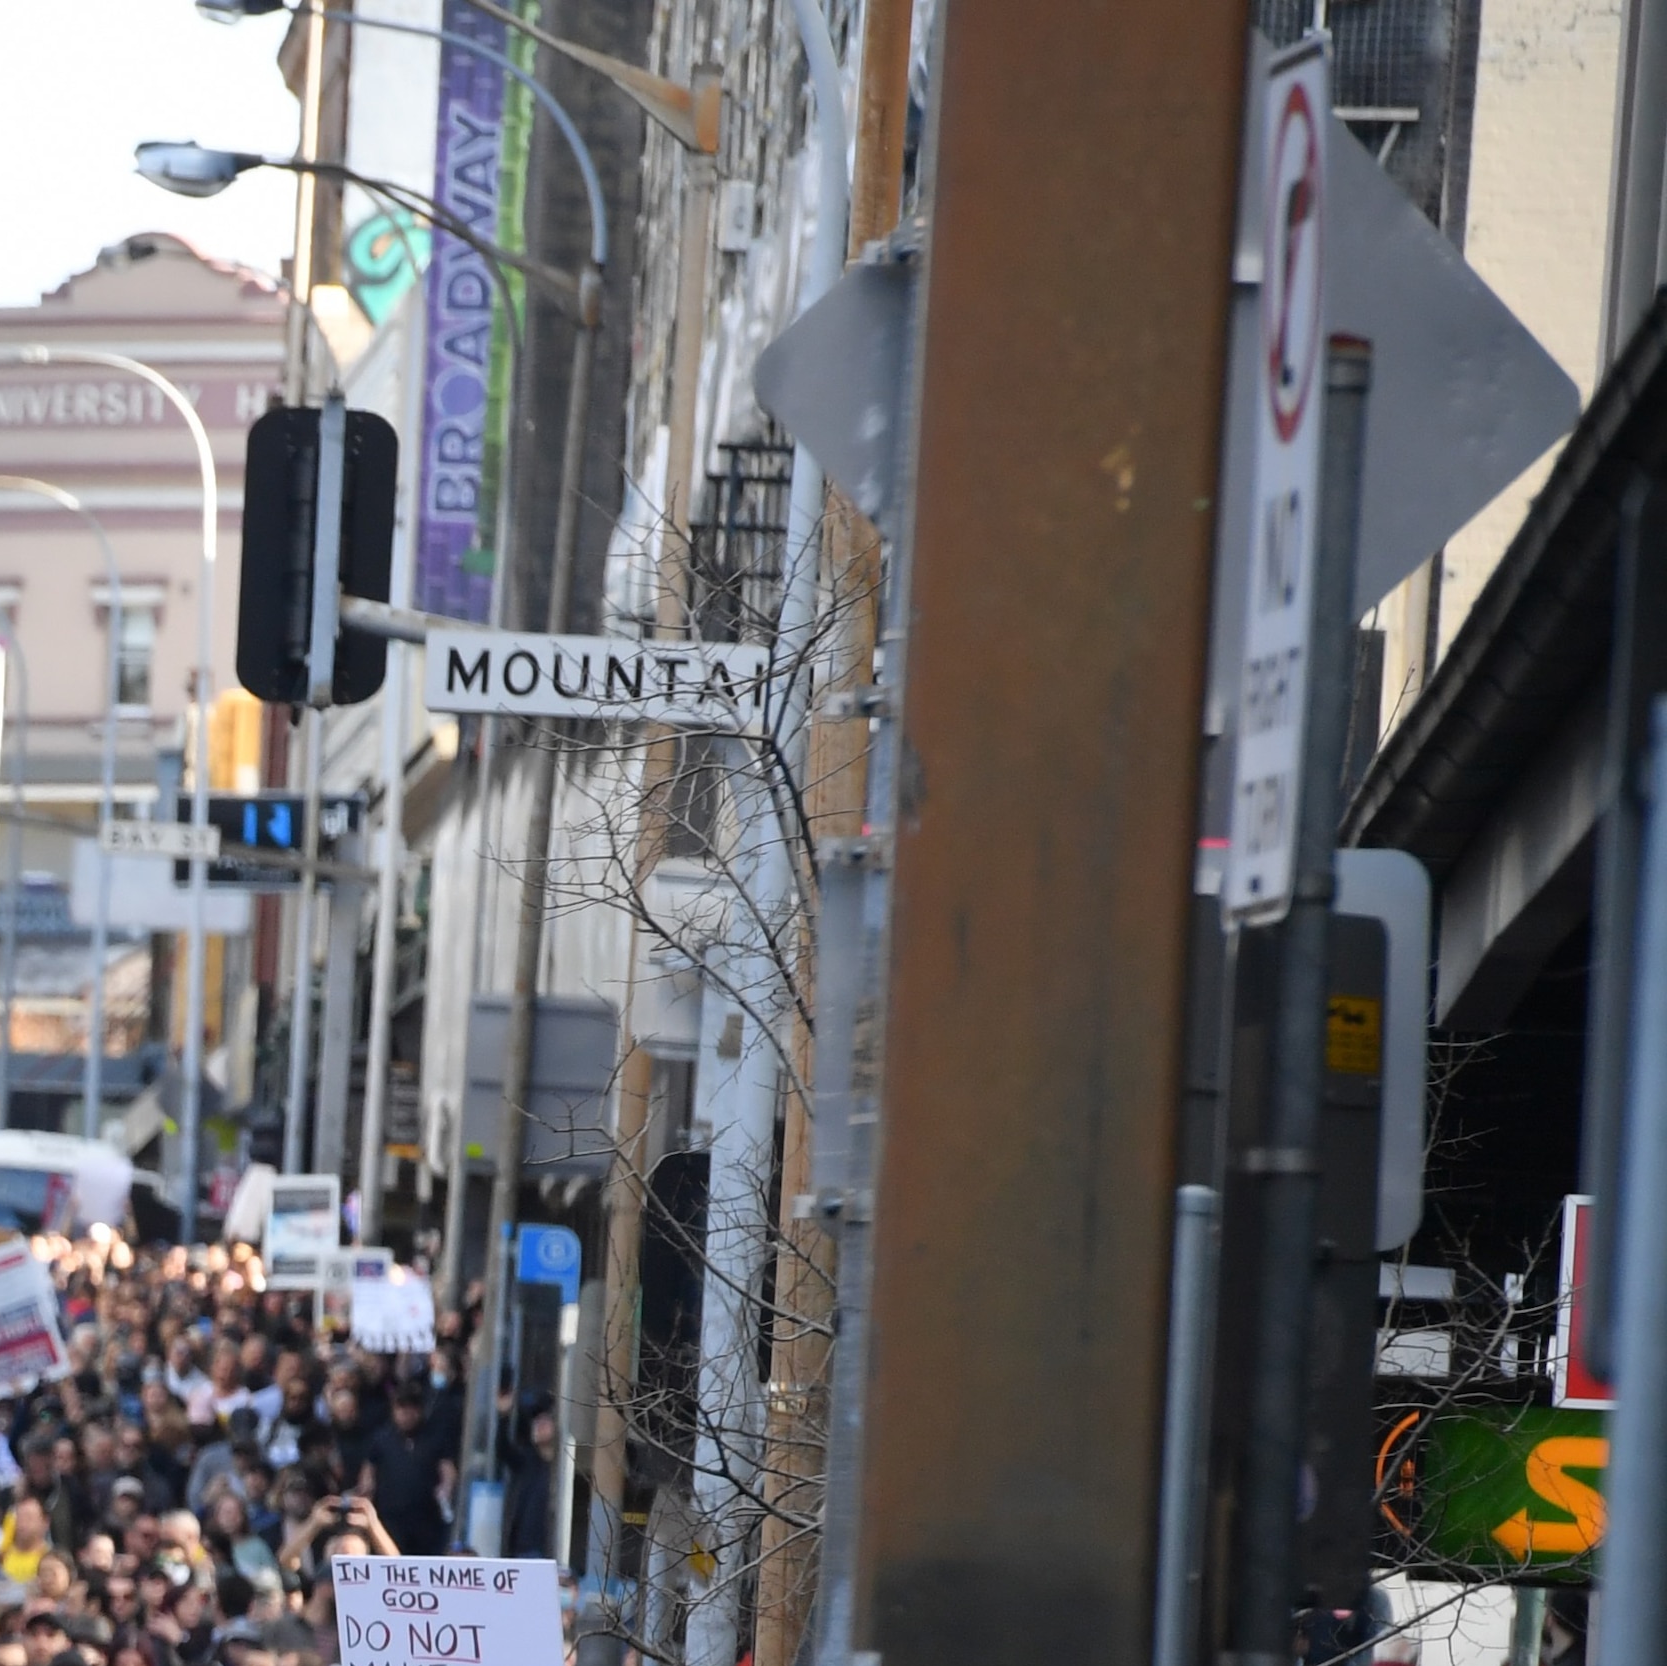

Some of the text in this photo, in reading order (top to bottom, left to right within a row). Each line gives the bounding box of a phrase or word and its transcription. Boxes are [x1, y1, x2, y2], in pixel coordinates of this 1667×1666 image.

[435, 112, 497, 514] BROADWAY
[337, 1562, 519, 1591] IN THE NAME OF
[382, 1588, 439, 1611] GOD
[346, 1614, 486, 1660] DO NOT
